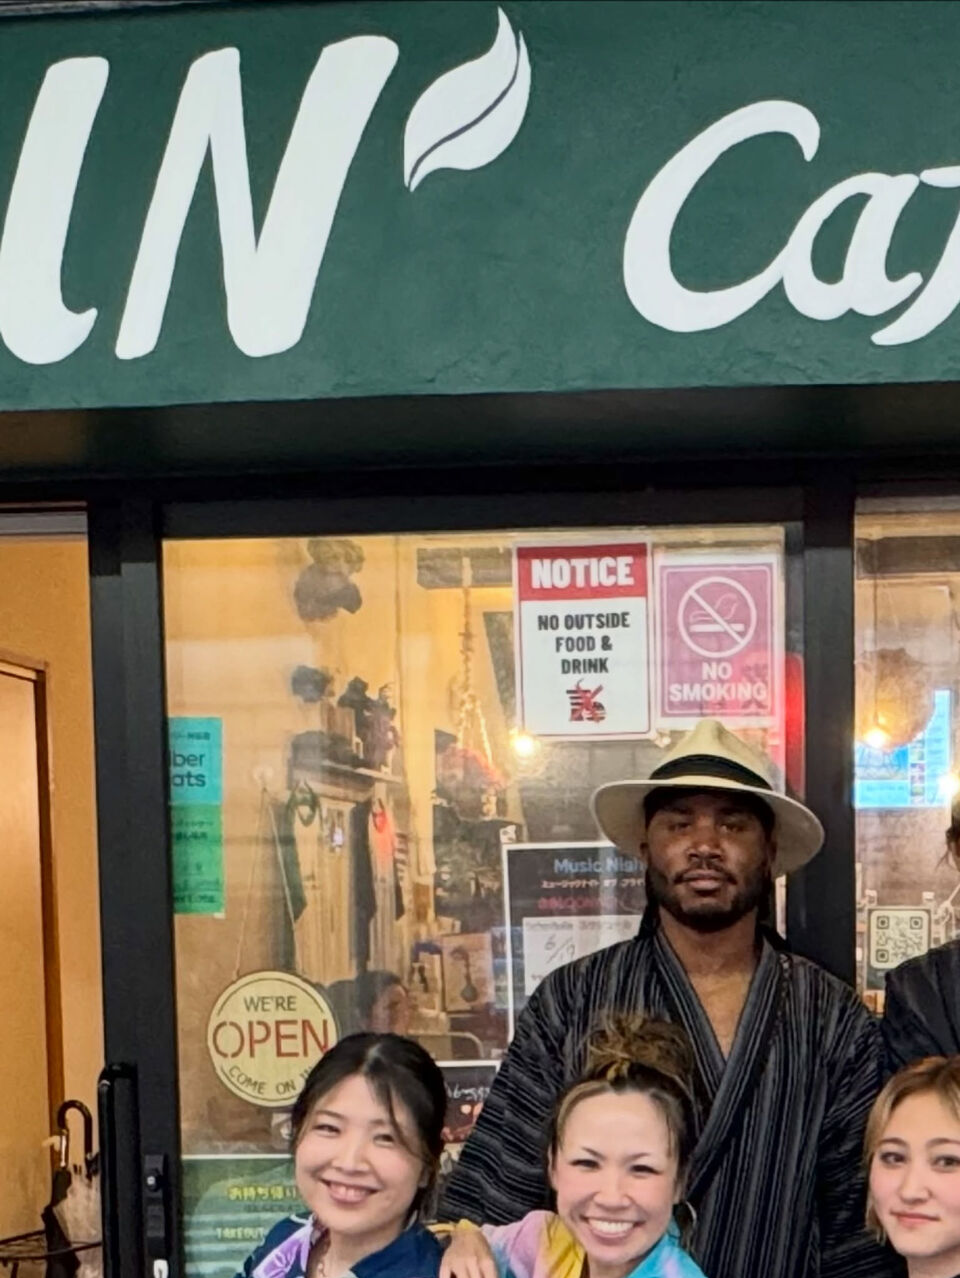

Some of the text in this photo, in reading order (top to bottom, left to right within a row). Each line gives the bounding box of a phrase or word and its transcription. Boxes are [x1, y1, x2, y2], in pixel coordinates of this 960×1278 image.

[531, 555, 635, 589] NOTICE
[537, 611, 630, 631] NO OUTSIDE
[555, 635, 613, 653] FOOD &
[561, 657, 609, 675] DRINK
[702, 662, 732, 679] NO
[669, 682, 768, 702] SMOKING
[172, 751, 205, 768] ber
[172, 770, 206, 787] ats
[554, 857, 647, 874] Music Nigh
[244, 995, 297, 1012] WE'RE
[212, 1018, 329, 1059] OPEN
[229, 1065, 297, 1095] COME ON
